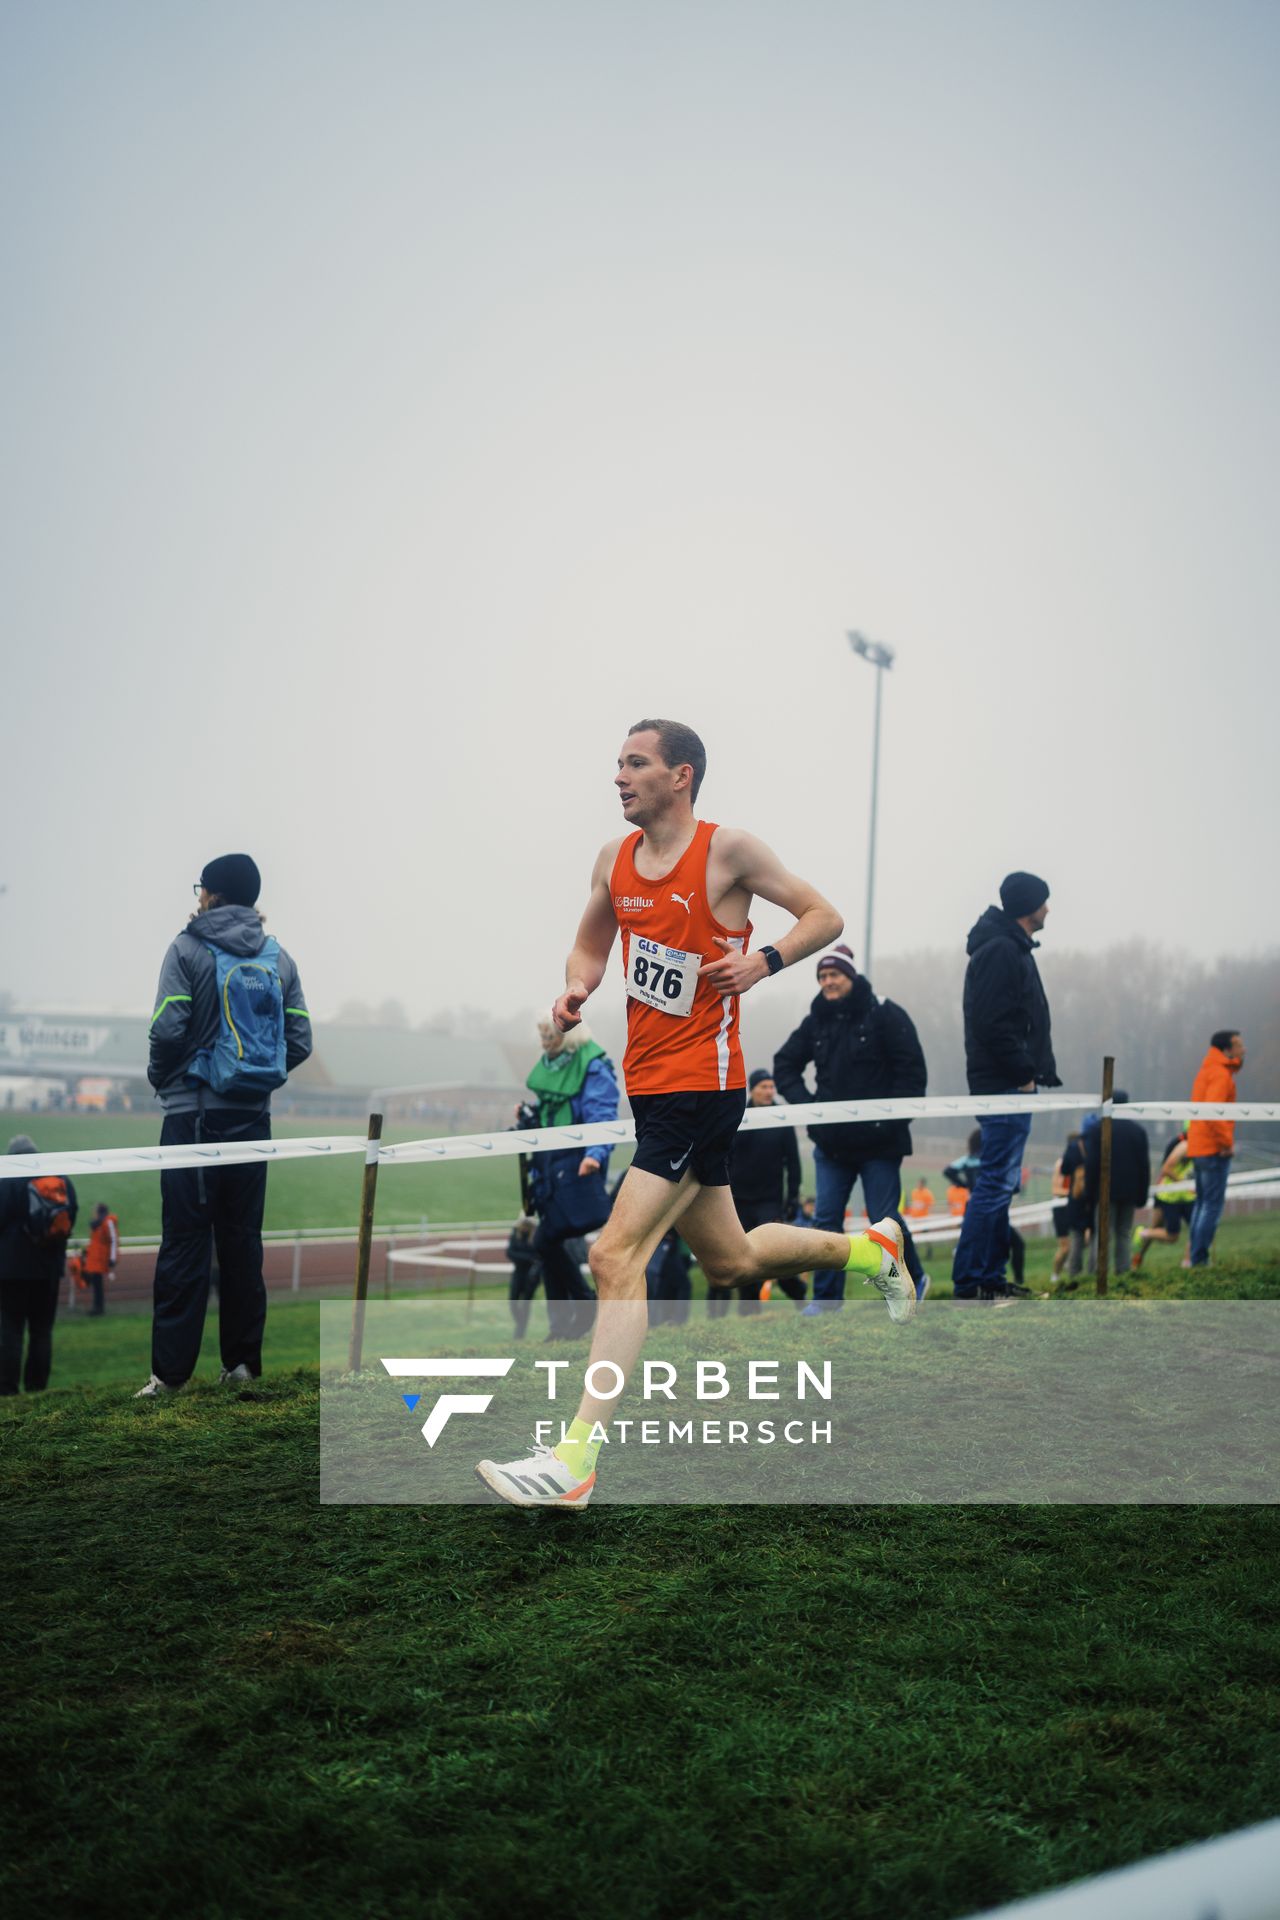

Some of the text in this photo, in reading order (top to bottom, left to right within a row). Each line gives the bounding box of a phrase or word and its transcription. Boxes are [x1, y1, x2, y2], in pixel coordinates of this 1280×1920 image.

[623, 896, 654, 907] Brillux
[638, 938, 659, 955] GLS
[633, 956, 684, 999] 876
